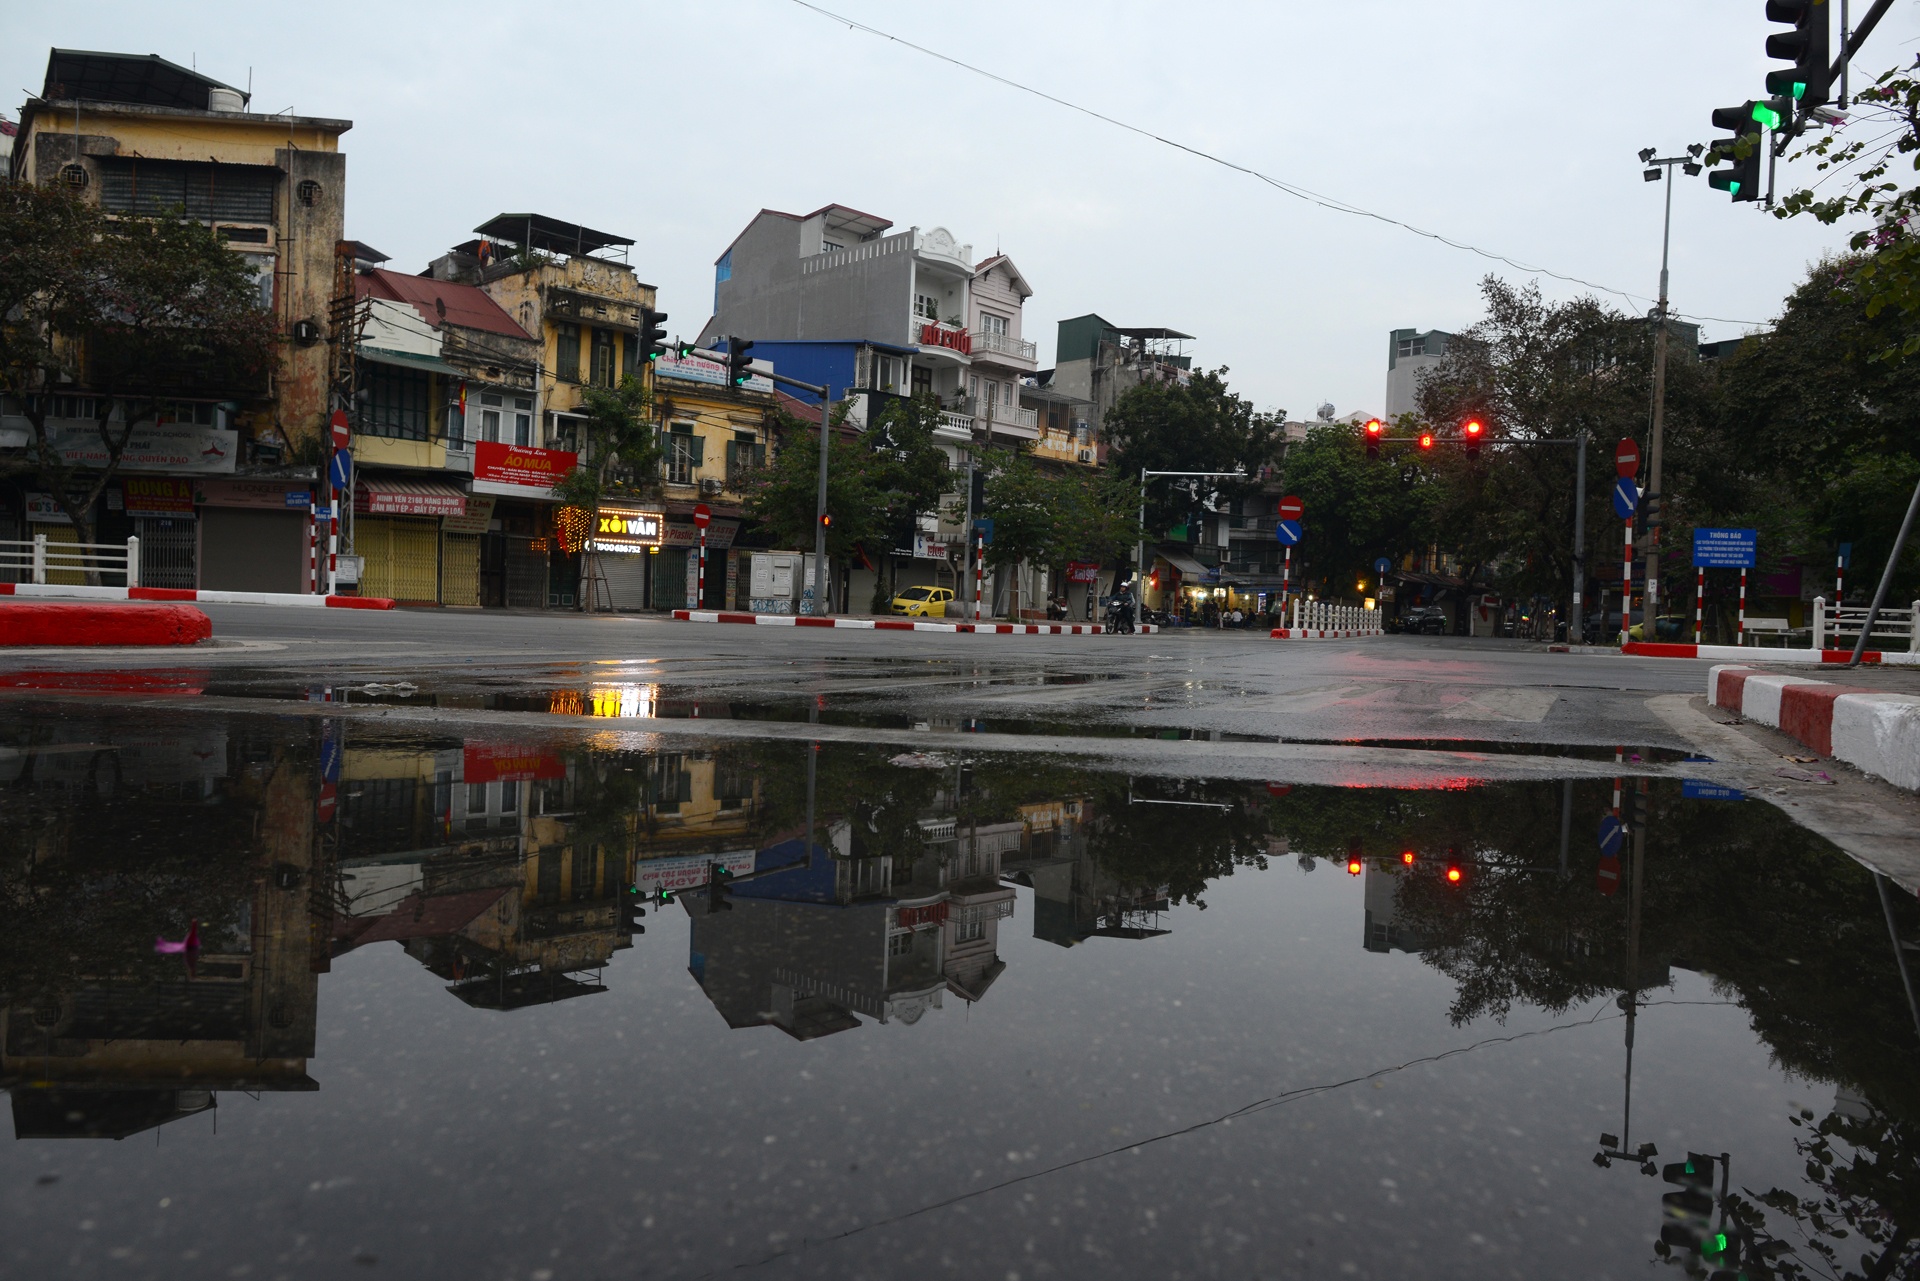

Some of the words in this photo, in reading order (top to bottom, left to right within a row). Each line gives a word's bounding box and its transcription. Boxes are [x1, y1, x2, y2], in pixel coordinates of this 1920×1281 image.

[922, 320, 940, 345] ÁO
[943, 328, 971, 355] CƯỚI
[503, 453, 523, 467] ÁO
[523, 458, 552, 471] MƯA
[376, 494, 393, 502] MINH
[424, 496, 441, 505] HÀNG
[372, 502, 385, 512] BÁN
[599, 514, 627, 534] XÔI
[627, 516, 657, 536] VÂN
[708, 525, 737, 535] PLASTIC
[670, 529, 694, 540] Plastic
[1709, 531, 1729, 539] THÔNG
[1730, 531, 1742, 539] BÁO
